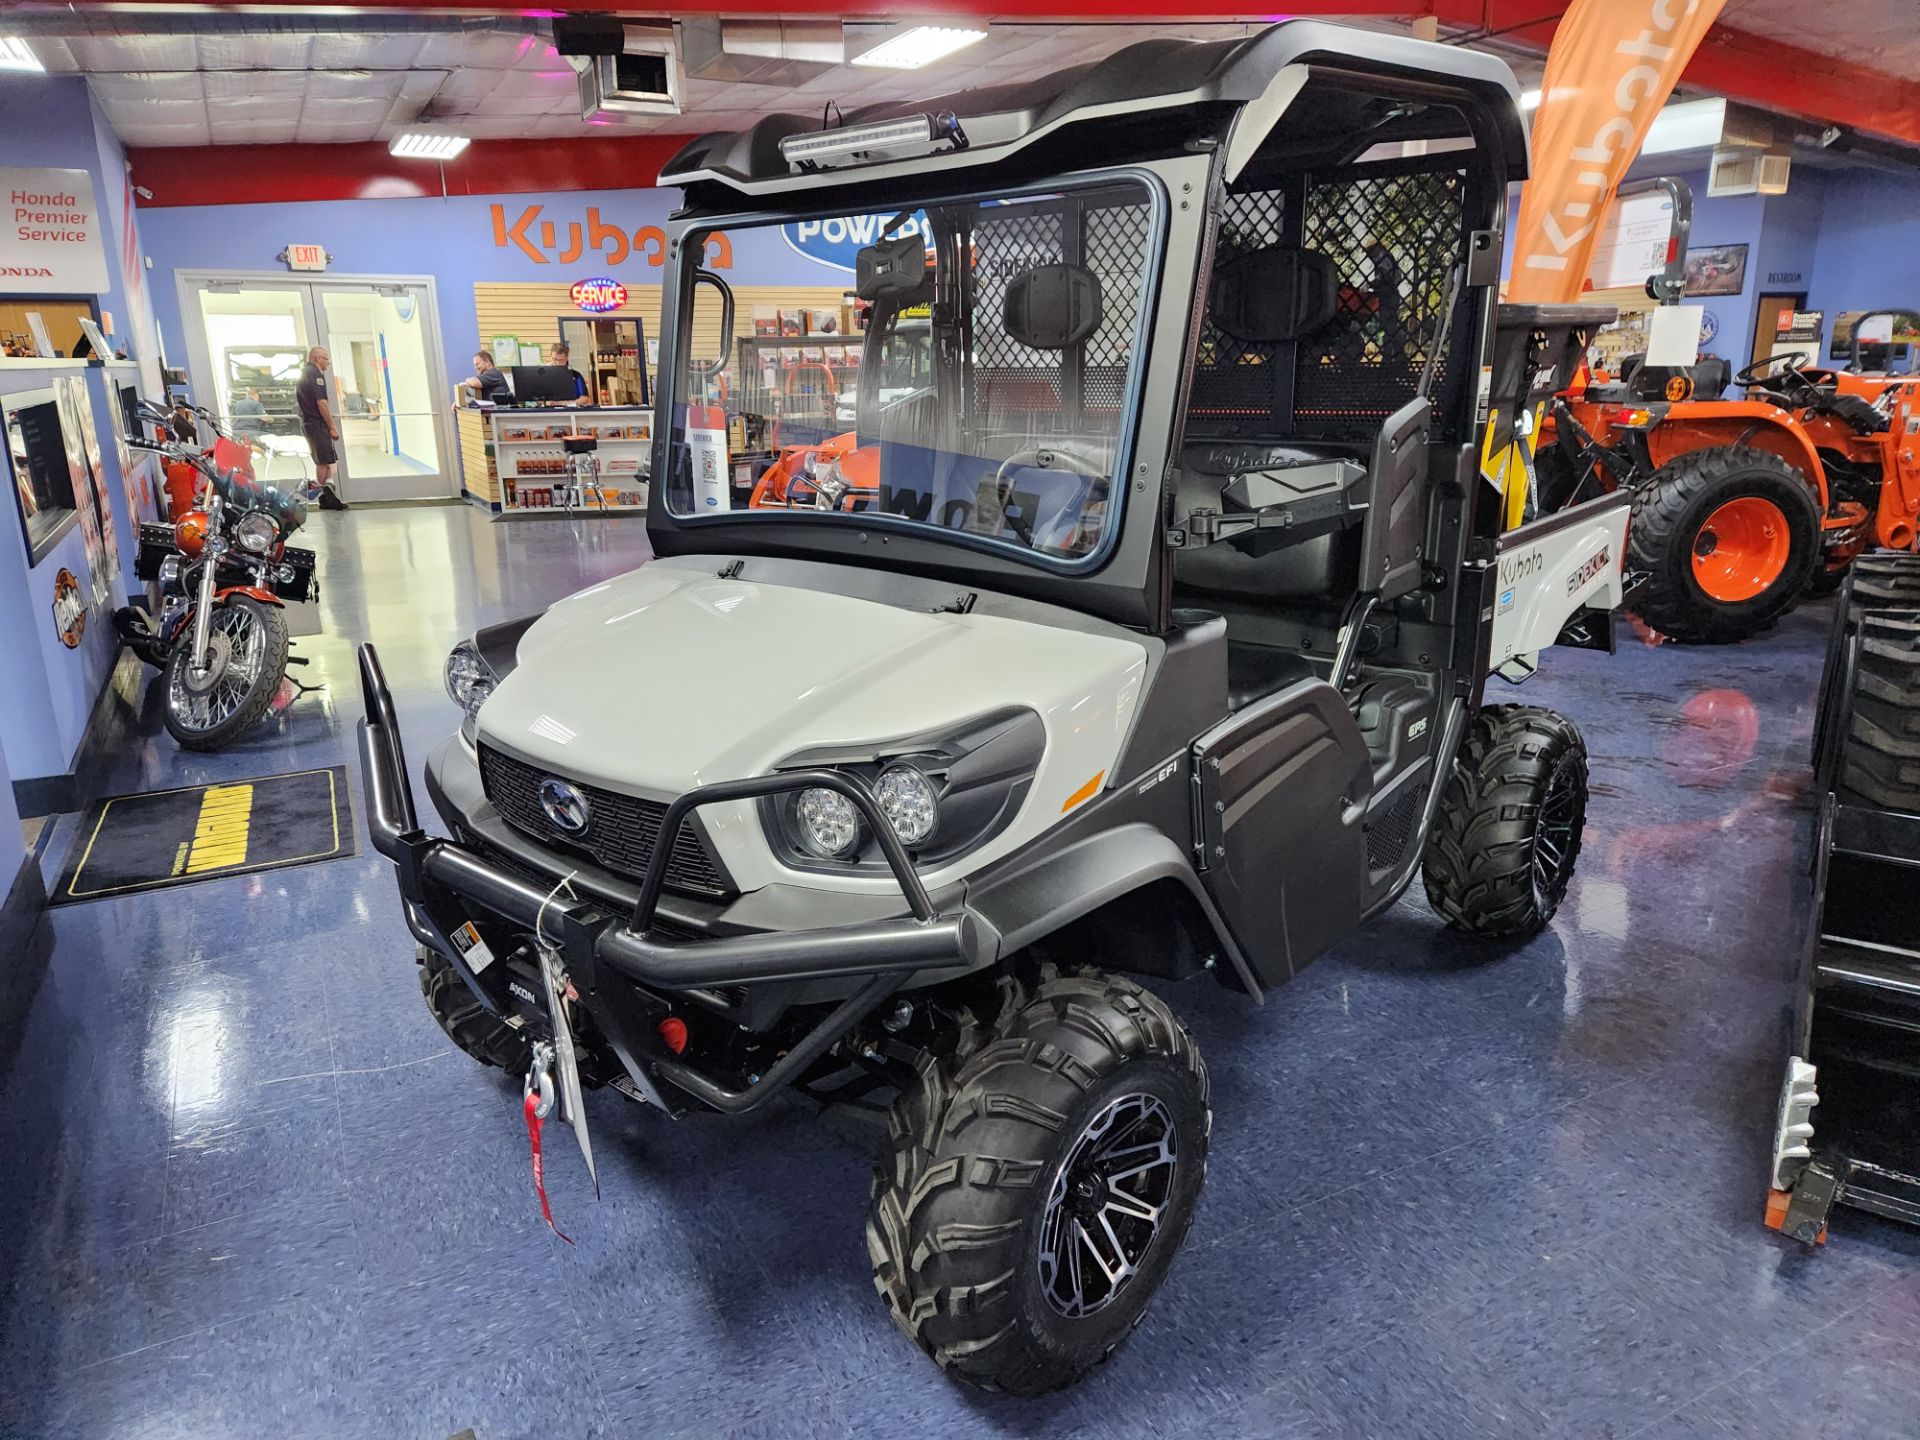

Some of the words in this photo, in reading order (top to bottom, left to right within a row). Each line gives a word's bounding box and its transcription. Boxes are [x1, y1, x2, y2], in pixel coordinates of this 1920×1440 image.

[11, 190, 76, 206] Honda
[15, 208, 88, 224] Premier
[18, 226, 86, 242] Service
[295, 246, 319, 262] EXIT
[572, 286, 625, 304] SERVICE
[1500, 546, 1542, 585] Kubota
[1158, 760, 1177, 782] EFI
[509, 982, 536, 1004] AXON
